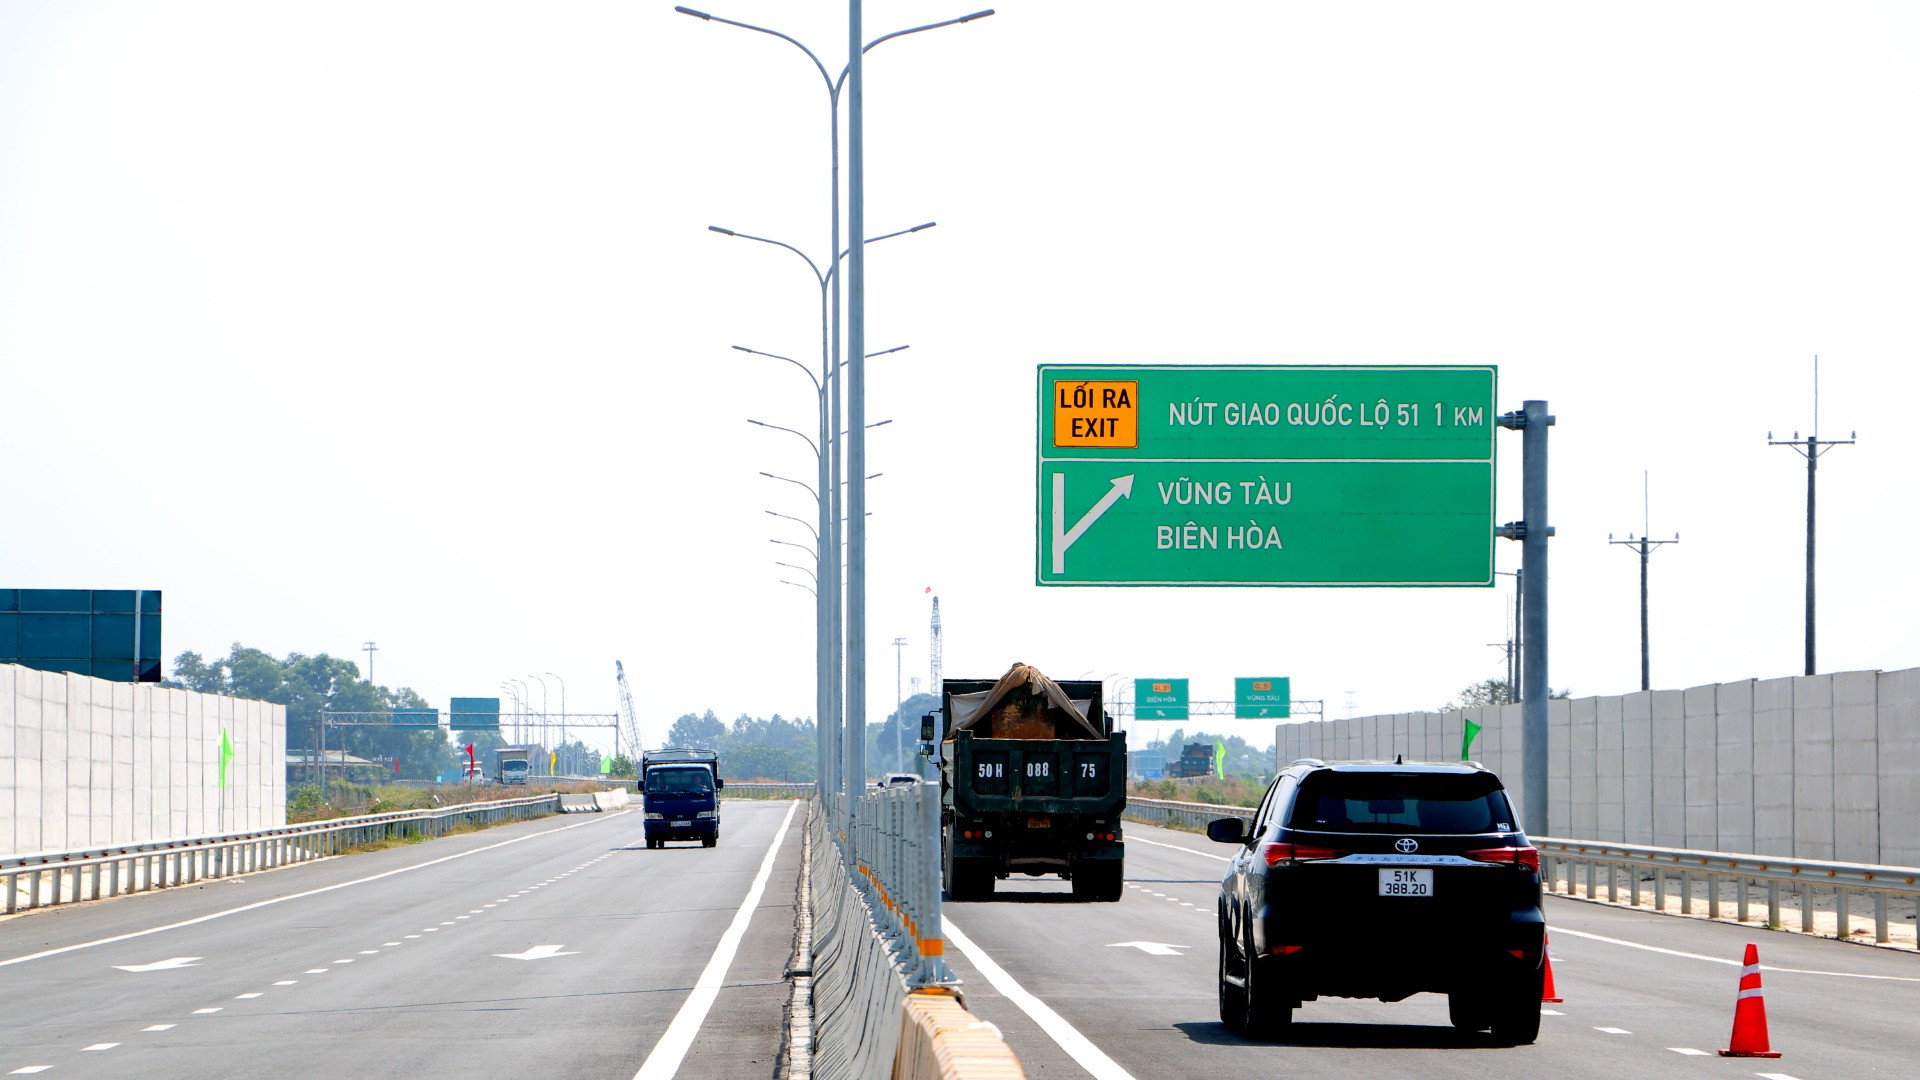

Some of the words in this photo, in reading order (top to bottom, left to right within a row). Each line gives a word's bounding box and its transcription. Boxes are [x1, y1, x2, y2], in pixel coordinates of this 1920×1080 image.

[1060, 381, 1094, 409] LỐI
[1102, 388, 1132, 409] RA
[1169, 396, 1218, 426] NÚT
[1224, 402, 1280, 426] GIAO
[1286, 393, 1353, 427] QUỐC
[1360, 398, 1390, 430] LỘ
[1397, 403, 1419, 426] 51
[1434, 402, 1442, 426] 1
[1454, 406, 1483, 426] KM
[1071, 418, 1119, 437] EXIT
[1157, 476, 1232, 505] VŨNG
[1239, 475, 1292, 506] TÀU
[1157, 520, 1218, 549] BIÊN
[1227, 519, 1283, 549] HÒA
[1026, 762, 1049, 777] 088
[1081, 763, 1096, 778] 75
[1394, 870, 1417, 882] 51K
[1385, 883, 1427, 895] 388.20
